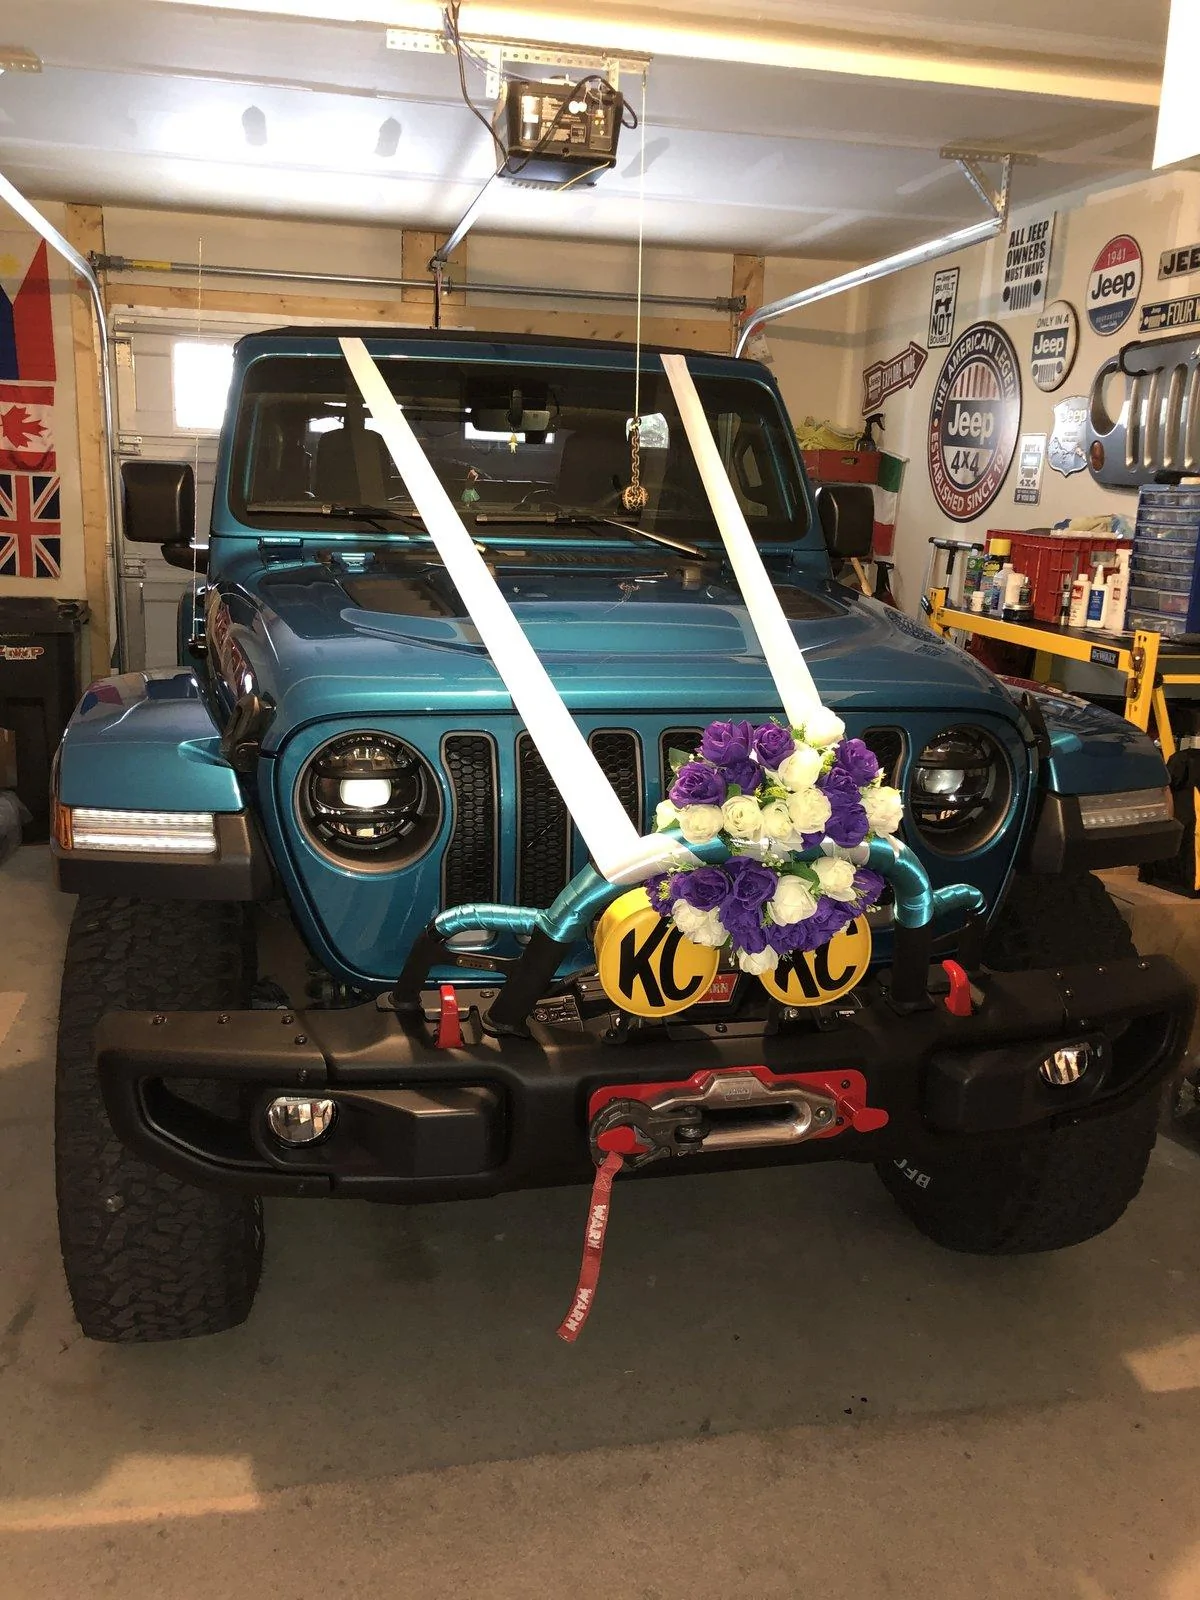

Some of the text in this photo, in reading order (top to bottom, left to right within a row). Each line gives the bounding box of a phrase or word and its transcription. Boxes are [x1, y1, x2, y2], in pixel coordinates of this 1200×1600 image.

[1009, 220, 1049, 248] ALL JEEP
[1006, 240, 1047, 268] OWNERS
[1107, 247, 1126, 266] 1941
[1163, 247, 1200, 275] JEE
[1005, 260, 1045, 283] MUST WAVE
[1091, 271, 1135, 300] Jeep
[935, 282, 955, 294] BUILT
[931, 313, 952, 335] NOT
[1036, 313, 1070, 328] ONLY IN A
[1166, 299, 1194, 326] FOUR
[1034, 334, 1064, 356] Jeep
[935, 332, 1016, 412] THE AMERICAN LEGEN
[948, 404, 994, 445] Jeep
[931, 431, 964, 512] ESTABLISHED
[966, 474, 995, 511] SINCE
[950, 451, 980, 478] 4X4
[1019, 480, 1036, 488] 4X4
[619, 915, 705, 1007] KC
[587, 1204, 608, 1249] WARN
[565, 1288, 593, 1332] WARN
